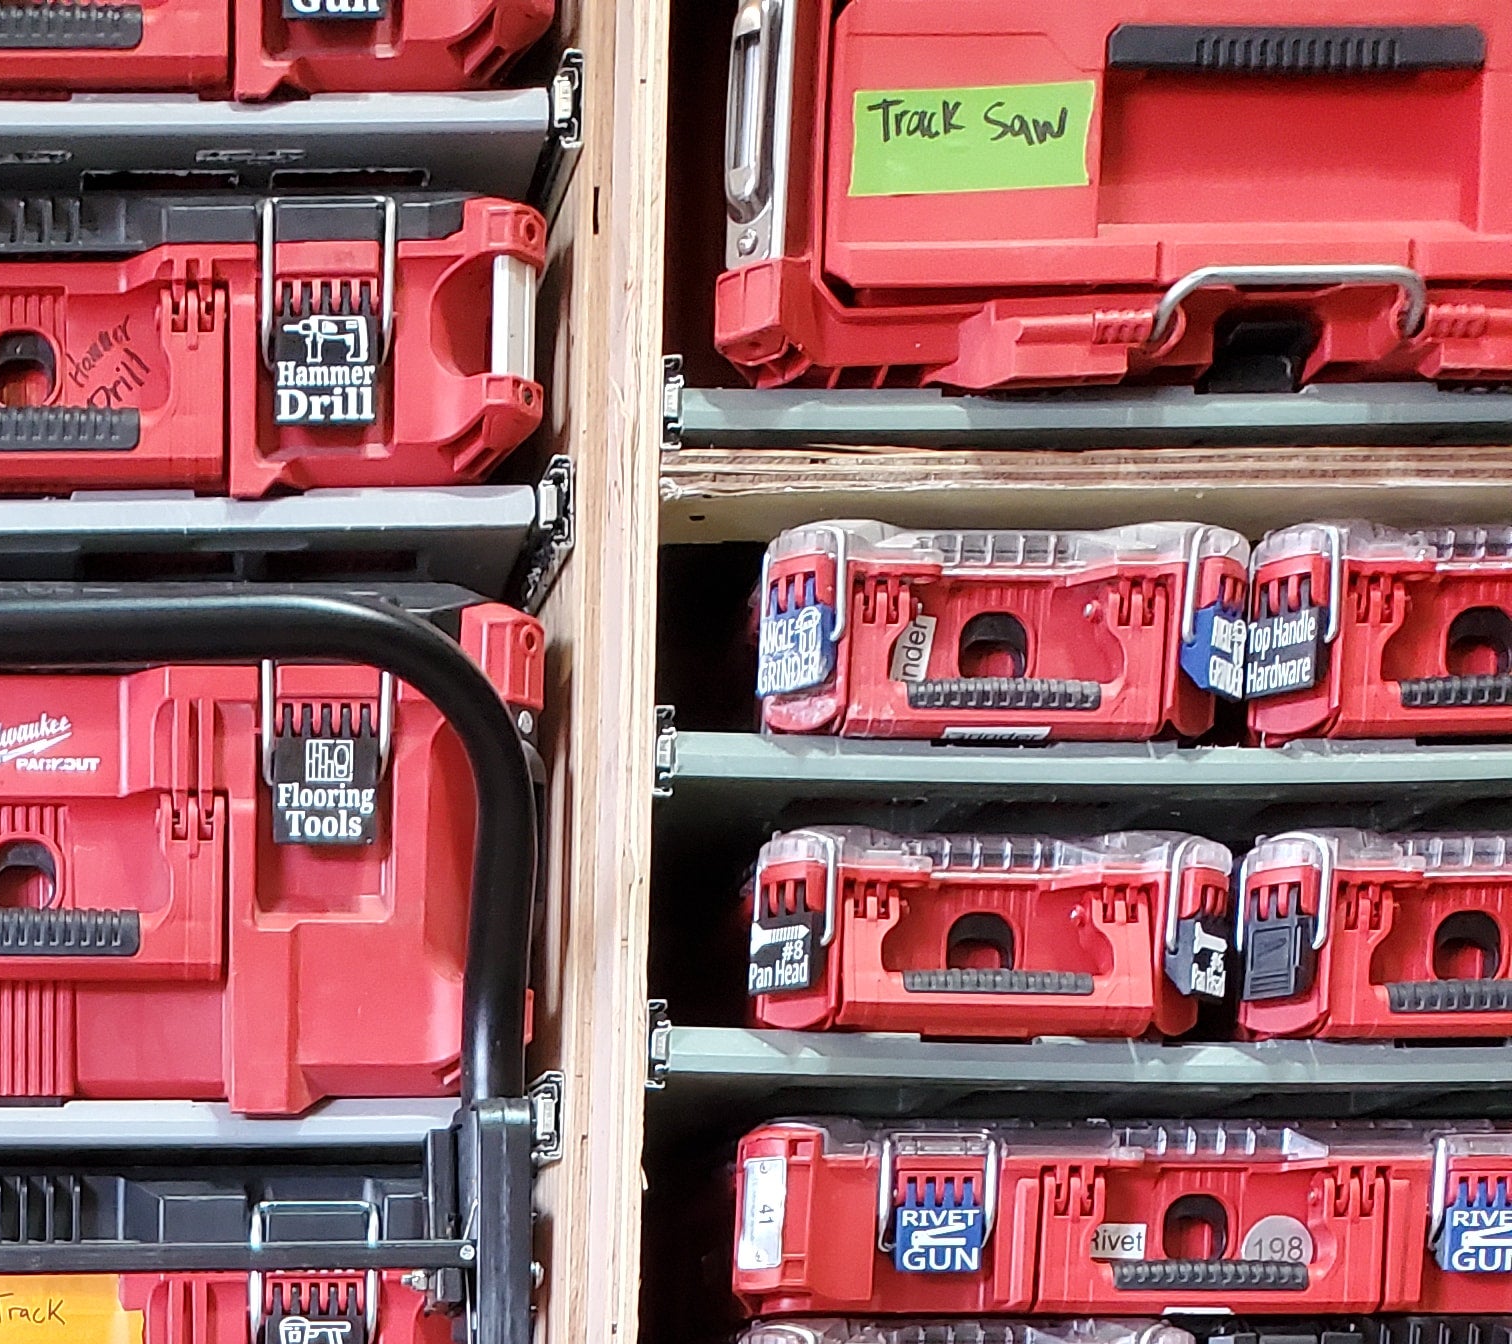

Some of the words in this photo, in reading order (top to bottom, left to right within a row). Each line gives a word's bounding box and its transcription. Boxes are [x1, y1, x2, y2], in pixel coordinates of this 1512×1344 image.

[866, 98, 966, 143] Track
[983, 101, 1069, 147] Saw
[276, 361, 376, 387] Hammer
[276, 386, 376, 421] Drill
[1248, 621, 1271, 661] Top
[1272, 609, 1316, 649] Handle
[757, 650, 820, 692] GRINDER
[1246, 654, 1311, 694] Hardware
[15, 757, 101, 772] PACKOUT
[277, 782, 375, 815] Flooring
[285, 809, 362, 838] Tools
[782, 940, 804, 961] #8
[748, 963, 773, 992] Pan
[775, 954, 809, 987] Head
[901, 1209, 980, 1227] RIVET
[902, 1247, 979, 1271] GUN
[1253, 1236, 1294, 1261] 198
